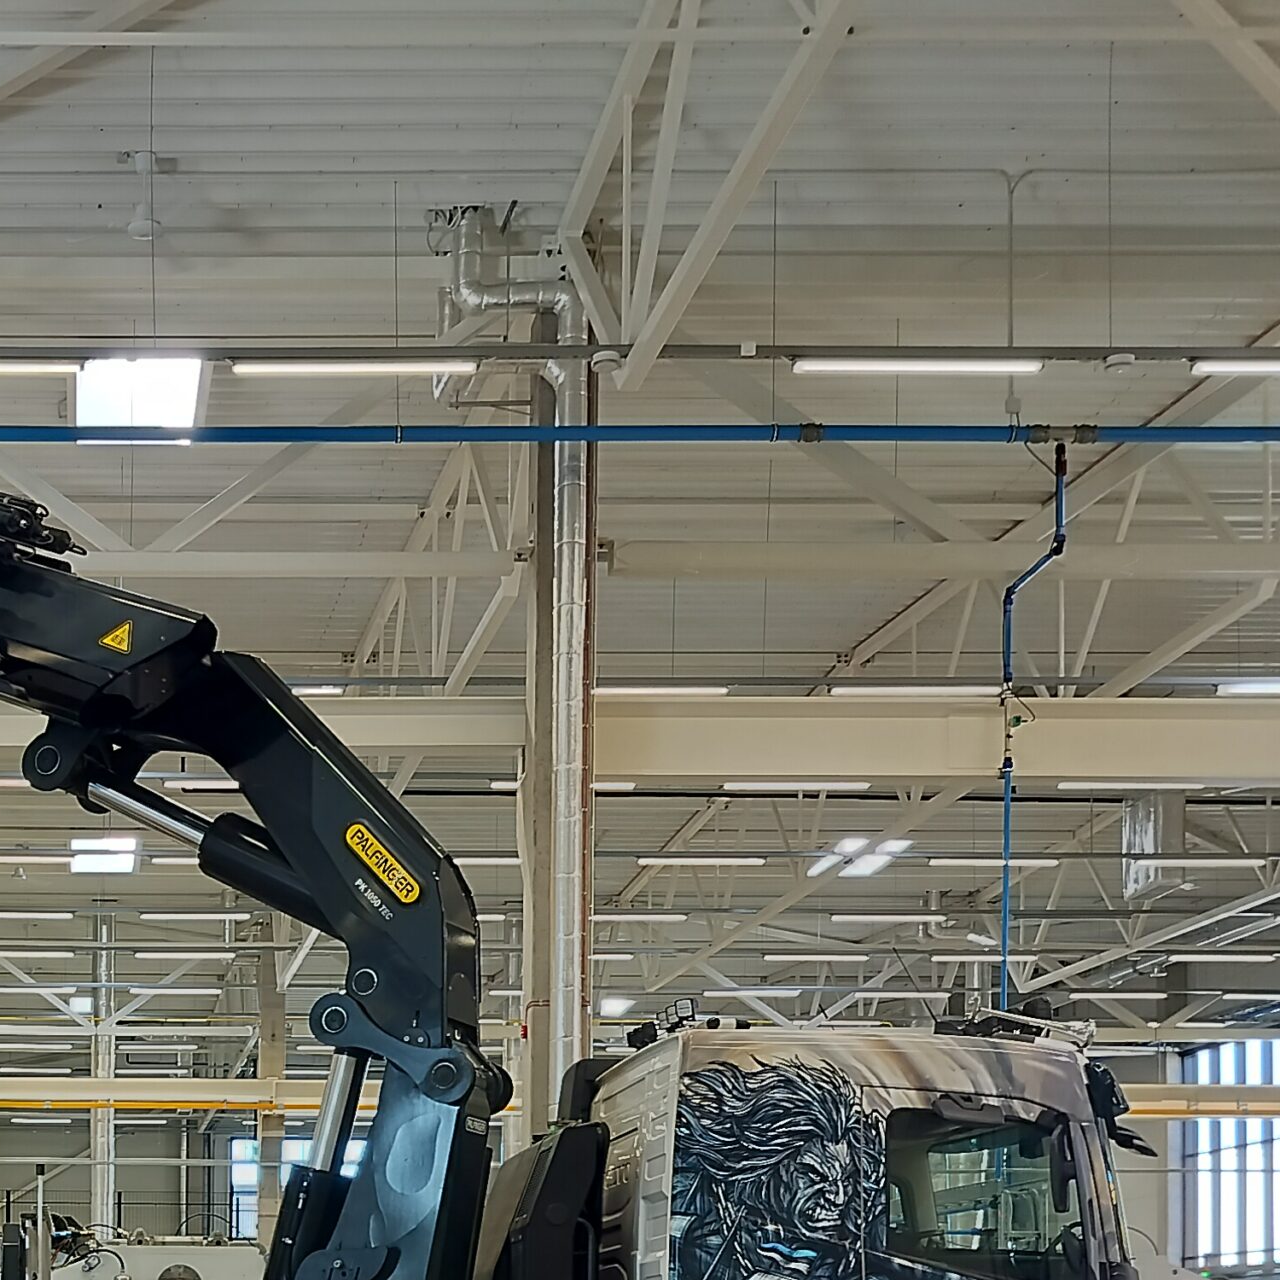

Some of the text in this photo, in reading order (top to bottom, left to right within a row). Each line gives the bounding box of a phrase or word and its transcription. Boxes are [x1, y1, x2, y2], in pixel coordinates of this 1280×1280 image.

[350, 828, 415, 899] PALFINGER
[354, 878, 394, 920] PK 1050 TEC
